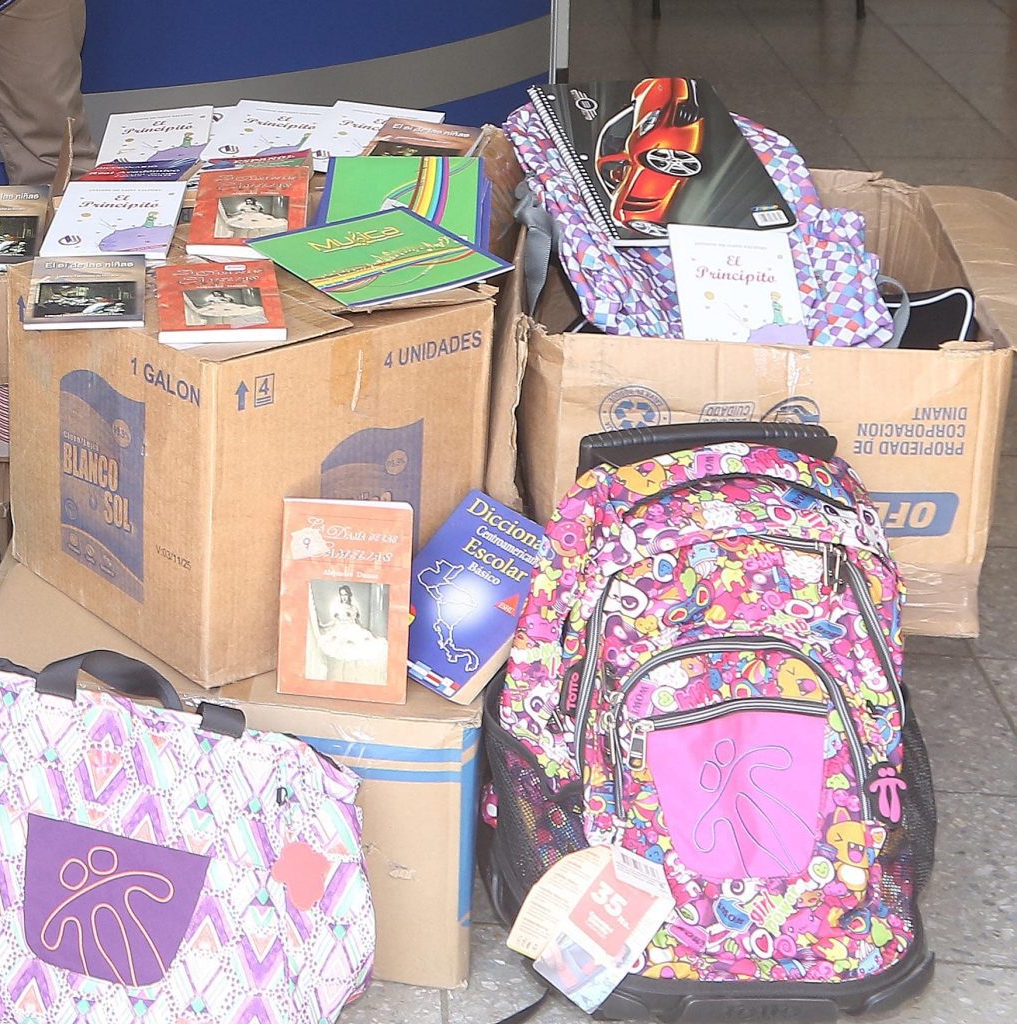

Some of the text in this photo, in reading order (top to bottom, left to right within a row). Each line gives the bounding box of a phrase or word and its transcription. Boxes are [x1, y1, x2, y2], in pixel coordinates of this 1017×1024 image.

[244, 117, 316, 131] Principito
[277, 114, 291, 123] El
[339, 119, 381, 133] Princ
[122, 124, 193, 135] Principito
[15, 192, 40, 201] niñas
[79, 201, 159, 210] Principito
[105, 261, 134, 269] niñas
[726, 255, 742, 267] El
[695, 266, 777, 285] Principito
[384, 330, 483, 369] 4 UNIDADES
[130, 357, 201, 407] 1 GALON
[911, 407, 968, 421] DINANT
[857, 423, 967, 440] CORPORACIÓN
[853, 440, 965, 456] PROPIEDAD DE
[63, 442, 120, 492] BLANCO
[103, 491, 132, 533] SOL
[466, 497, 542, 550] Dicciona
[476, 525, 540, 568] Centroamerican
[462, 536, 529, 583] Escolar
[467, 561, 502, 586] Básico
[566, 672, 579, 711] TOTTO
[590, 880, 629, 918] 35
